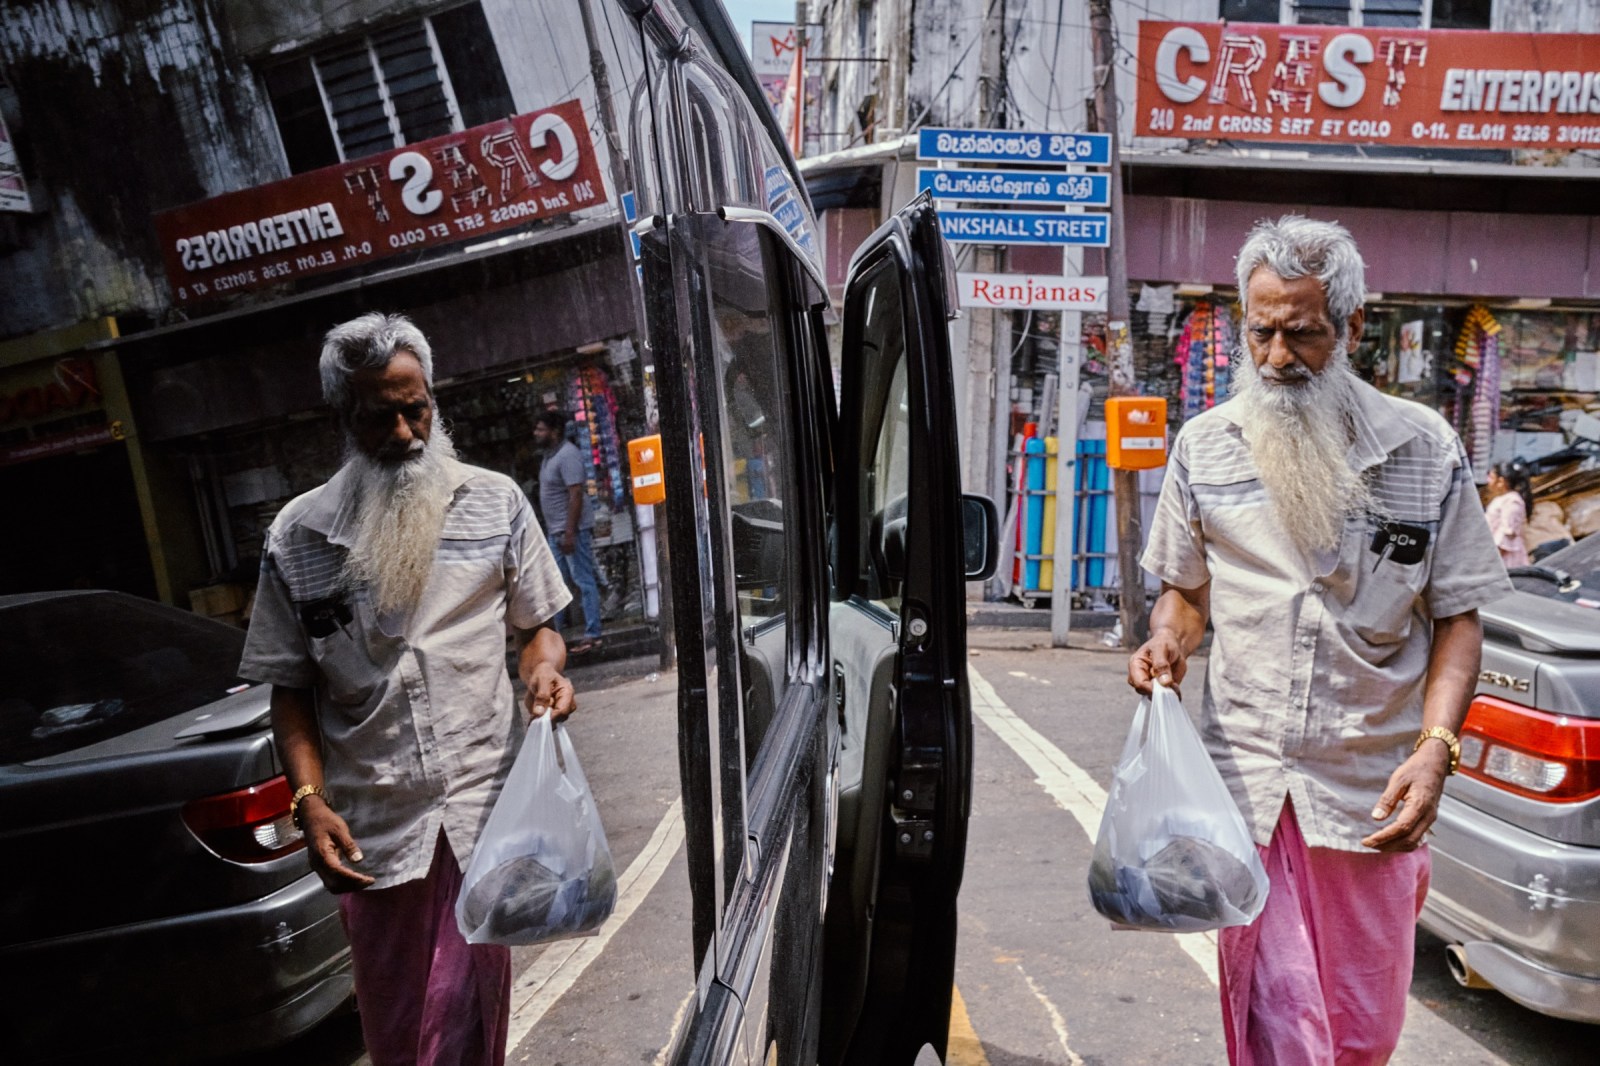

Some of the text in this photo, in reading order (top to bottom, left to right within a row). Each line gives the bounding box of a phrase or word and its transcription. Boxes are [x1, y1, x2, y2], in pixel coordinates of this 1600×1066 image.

[1150, 108, 1175, 131] 240
[1182, 114, 1214, 132] 2nd
[1218, 115, 1273, 134] CROSS
[1320, 119, 1345, 137] ET
[1347, 119, 1392, 138] COLO
[1055, 176, 1093, 200] வீதி
[938, 216, 1105, 239] ANKSHALL STREET
[972, 278, 1096, 306] Ranjanas
